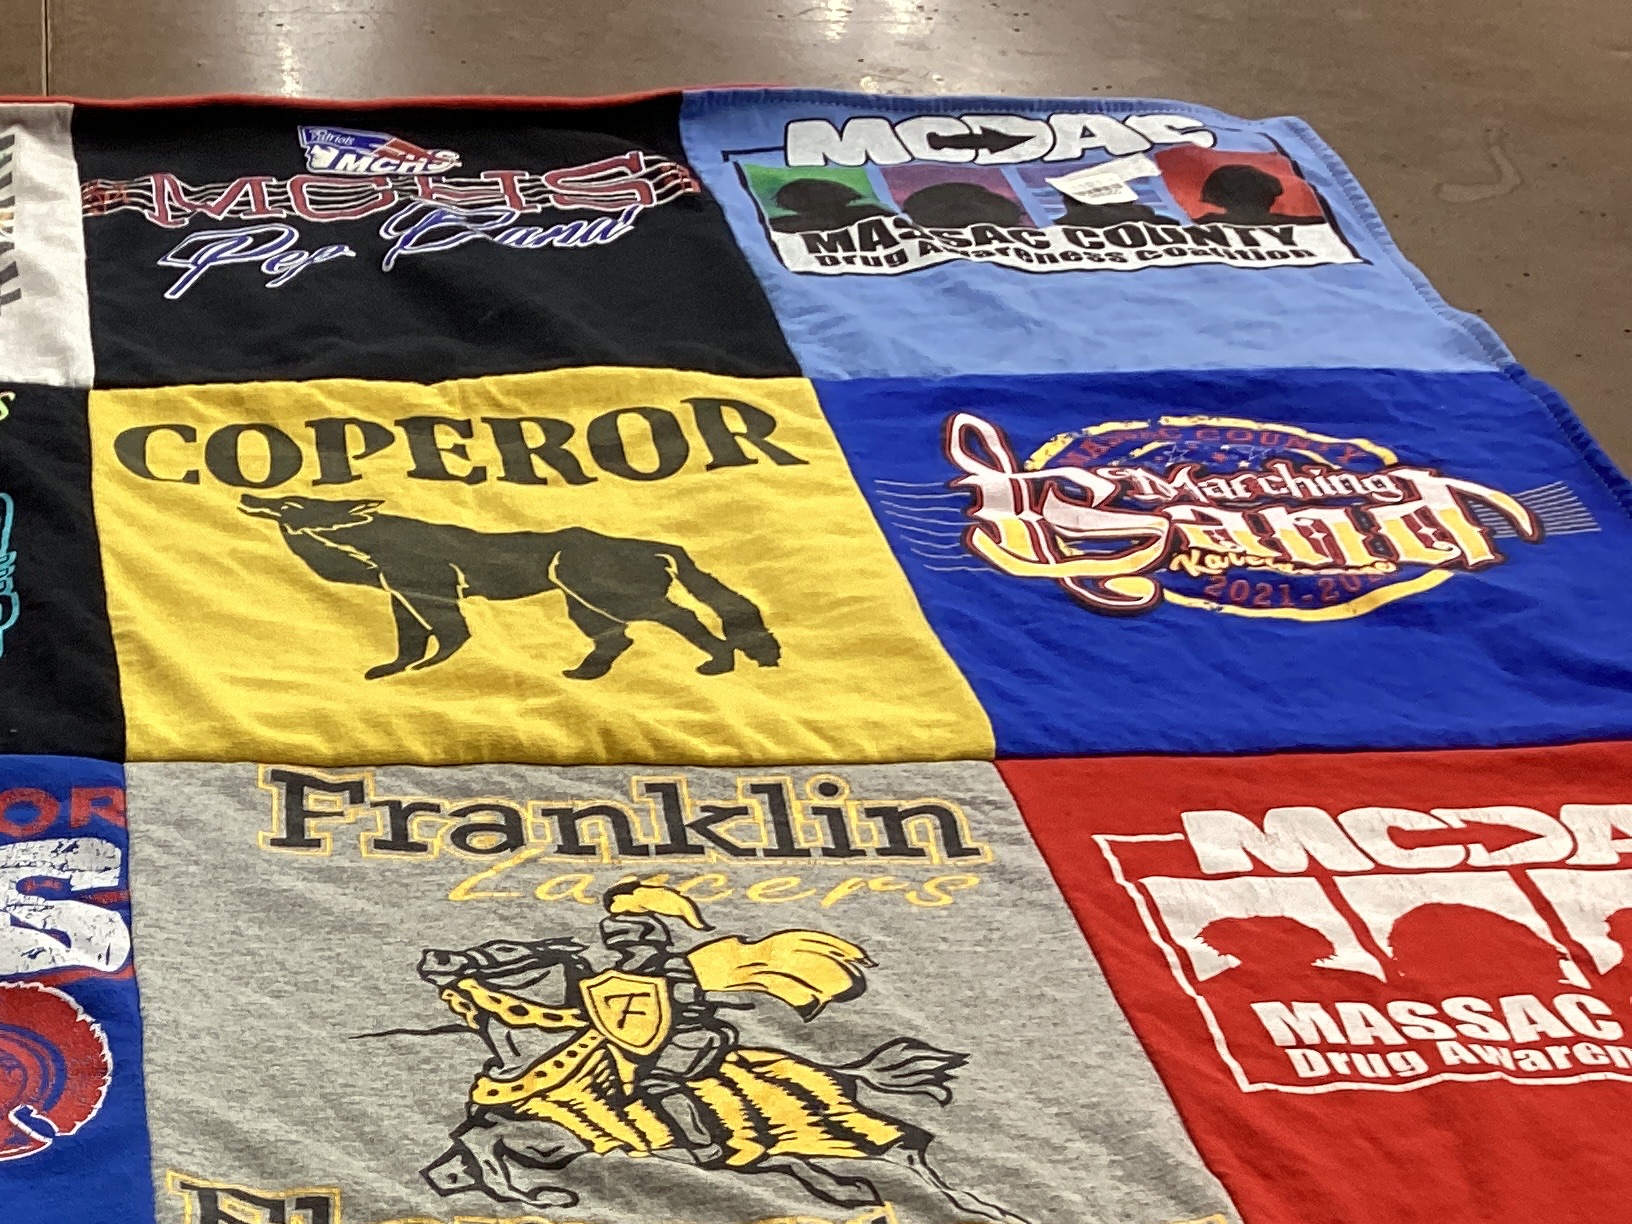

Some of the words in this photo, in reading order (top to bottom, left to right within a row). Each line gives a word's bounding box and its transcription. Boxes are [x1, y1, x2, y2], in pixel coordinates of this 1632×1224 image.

[145, 151, 654, 229] MCHS
[335, 150, 462, 173] MCHS
[158, 224, 356, 299] Pep
[380, 200, 641, 271] Band
[816, 249, 909, 268] Drug
[919, 238, 1128, 264] Awareness
[1067, 221, 1298, 249] COUNTY
[113, 396, 810, 489] COPEROR
[943, 411, 1541, 608] Band
[1098, 460, 1396, 505] Marching
[259, 764, 994, 866] Franklin
[448, 847, 982, 908] Lacers
[1250, 993, 1624, 1046] MASSAC
[1284, 1047, 1429, 1079] Drug
